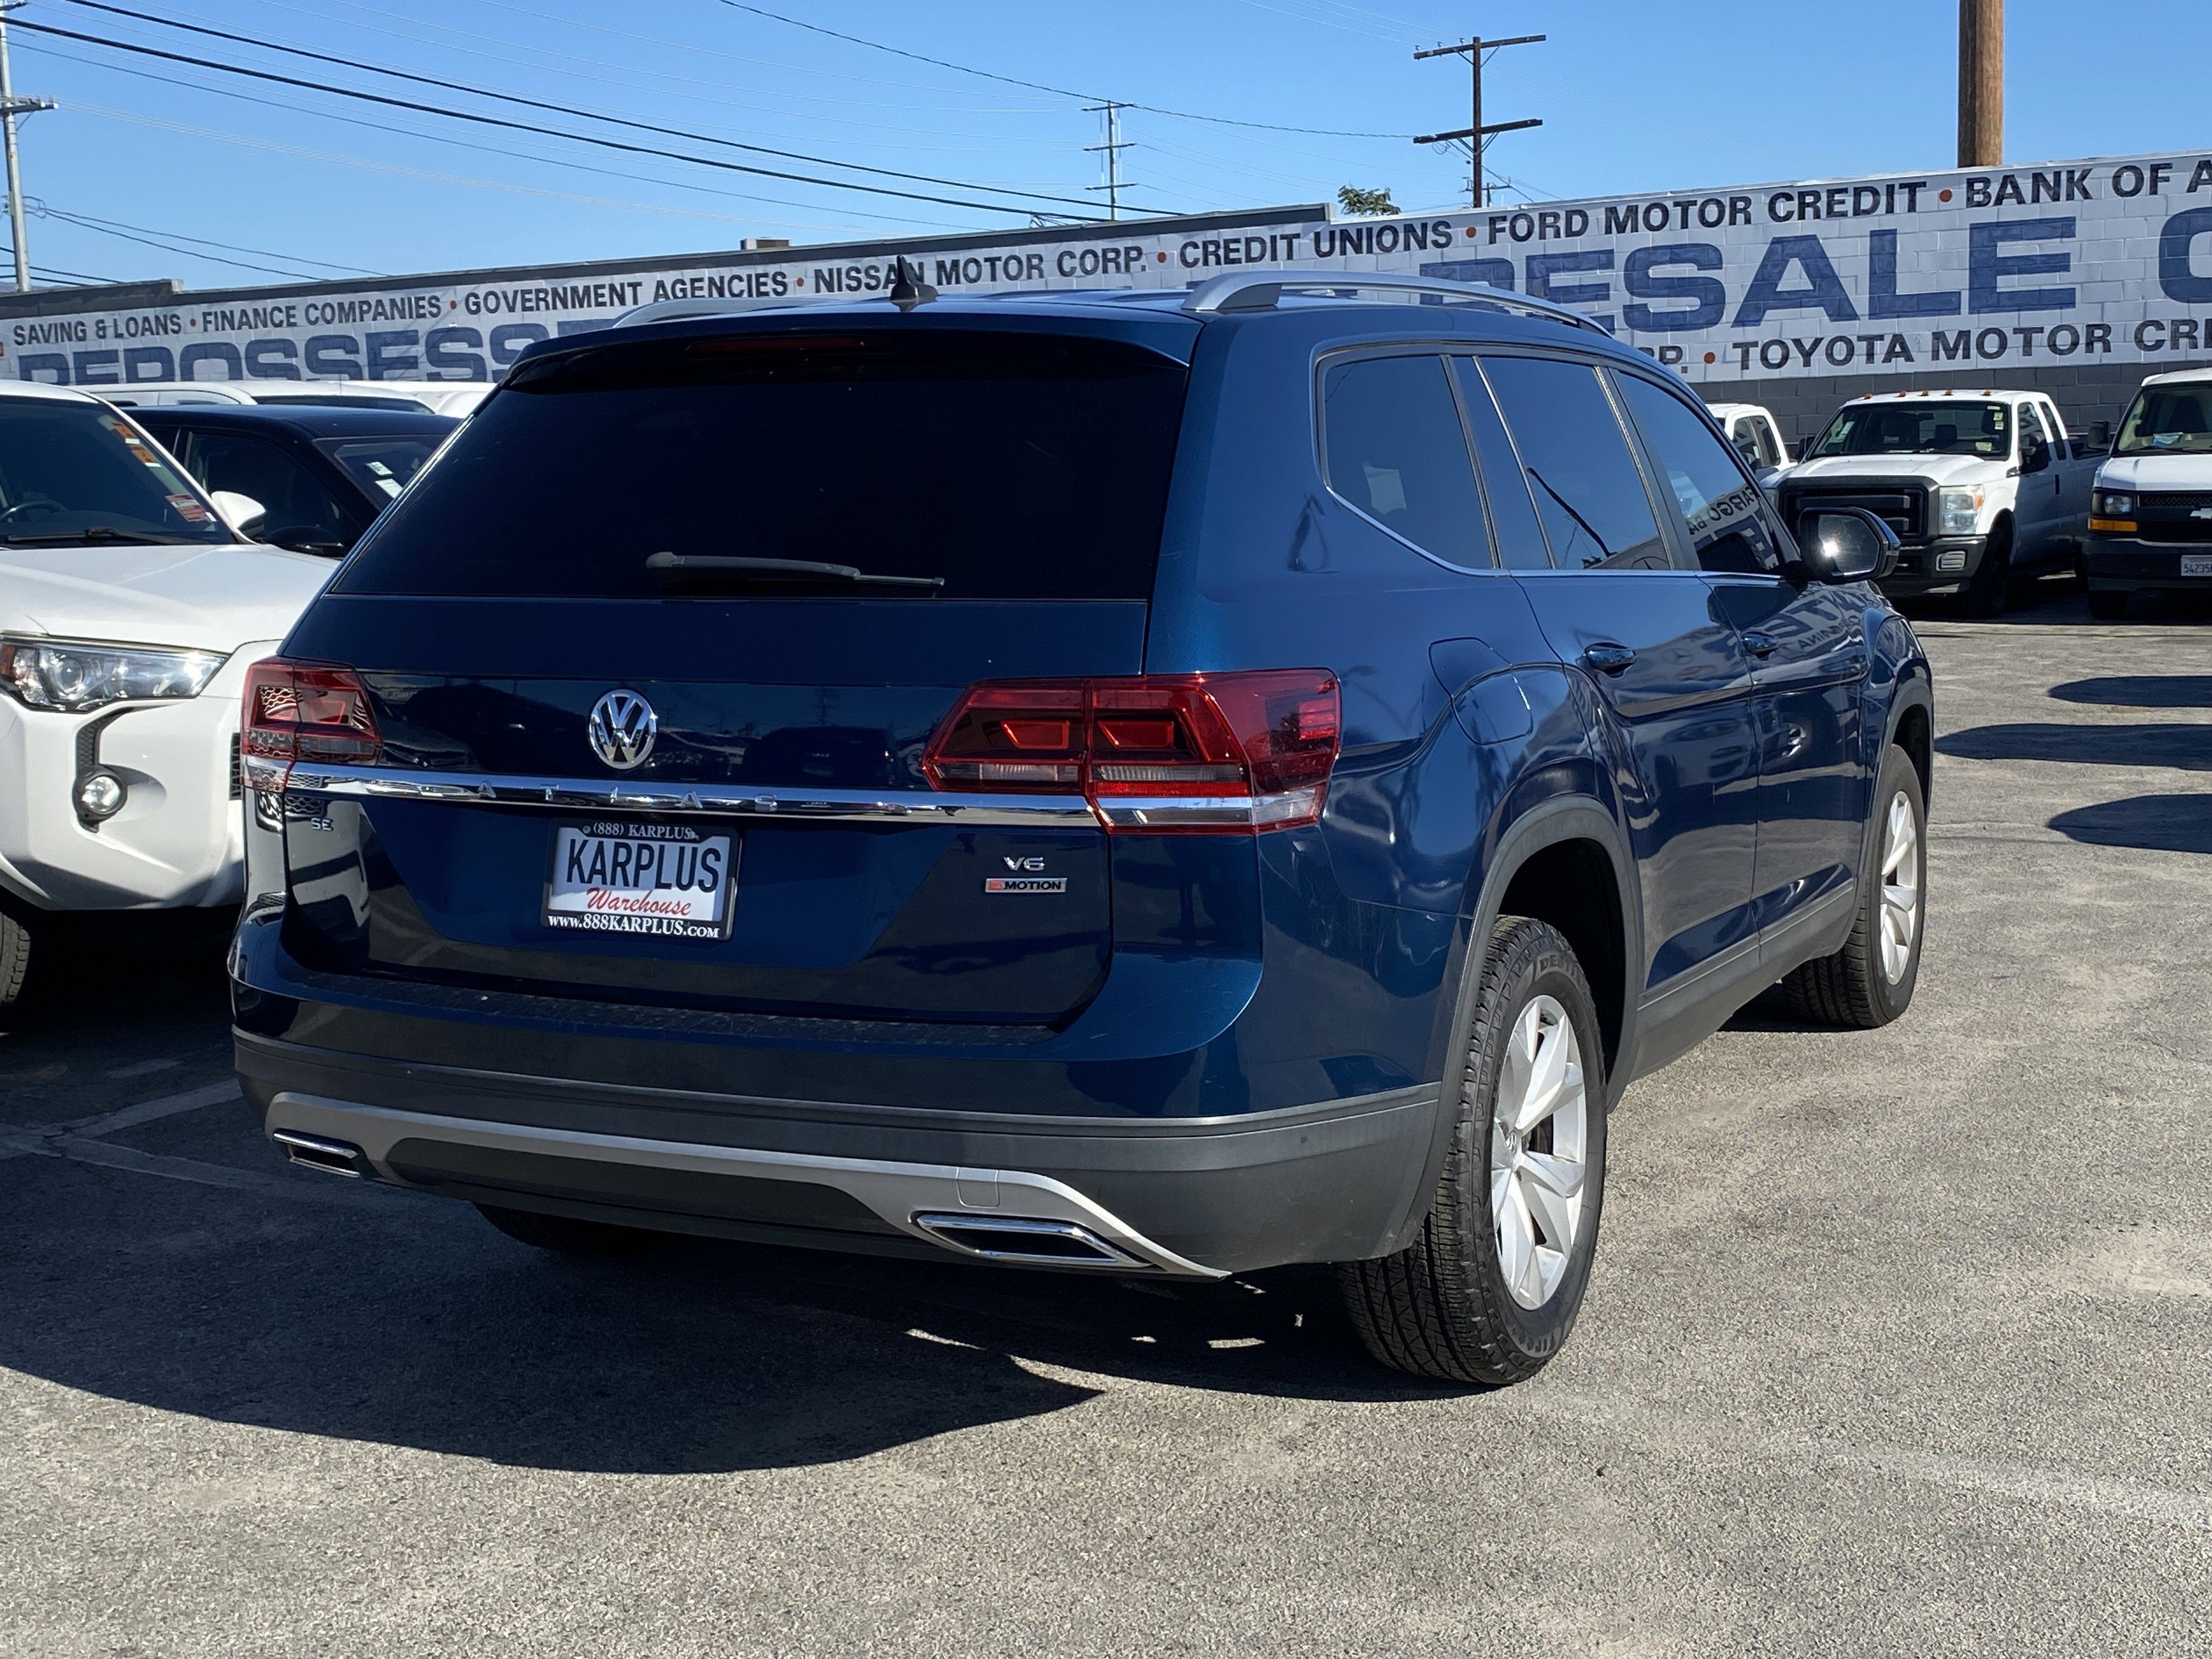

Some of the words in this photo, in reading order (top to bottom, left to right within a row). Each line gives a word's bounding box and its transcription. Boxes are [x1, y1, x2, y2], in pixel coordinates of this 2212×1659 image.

[14, 320, 86, 346] SAVING
[113, 314, 182, 338] LOANS
[202, 305, 297, 332] FINANCE
[305, 295, 441, 325] COMPANIES
[465, 281, 642, 315] GOVERNMENT
[653, 271, 788, 303] AGENCIES
[814, 262, 924, 294] NISSAN
[936, 253, 1043, 286] MOTOR
[1057, 245, 1147, 277] CORP.
[1180, 233, 1301, 268] CREDIT
[1314, 220, 1453, 258] UNIONS
[1488, 209, 1589, 244] FORD
[1604, 196, 1752, 235] MOTOR
[1768, 181, 1927, 222] CREDIT
[1966, 168, 2093, 208] BANK
[2112, 162, 2173, 198] OF
[18, 318, 616, 383] REPOSSESS
[1732, 333, 1914, 370] TOYOTA
[1932, 321, 2112, 360] MOTOR
[2184, 563, 2212, 573] 54235
[311, 817, 332, 831] SE
[593, 822, 624, 837] (888)
[628, 824, 695, 840] KARPLUS
[566, 839, 721, 893] KARPLUS
[1003, 856, 1045, 871] V6
[586, 887, 691, 916] Warehouse
